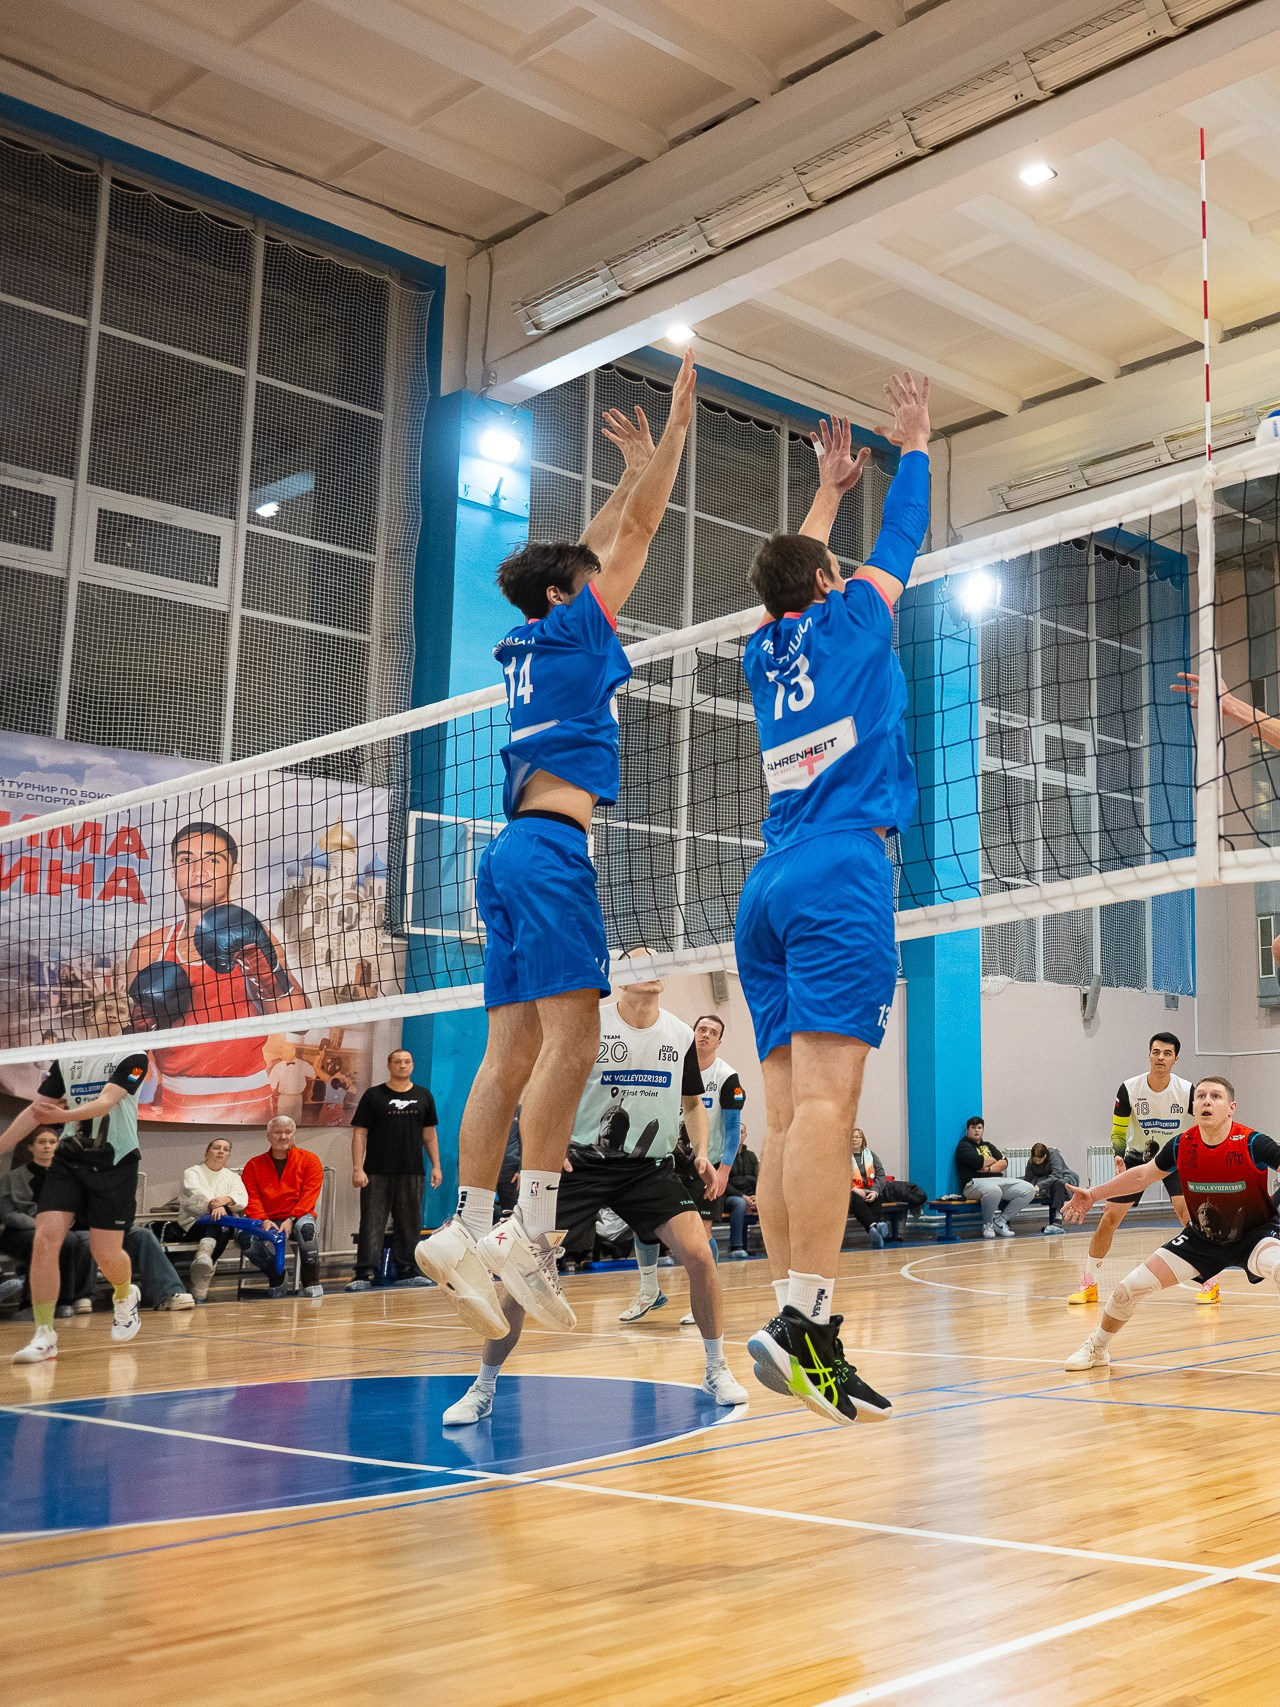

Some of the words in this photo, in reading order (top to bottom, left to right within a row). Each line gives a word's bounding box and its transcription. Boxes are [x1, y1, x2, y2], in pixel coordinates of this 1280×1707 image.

[504, 652, 534, 709] 14
[765, 653, 815, 721] 13
[0, 789, 24, 799] ТЕР
[26, 793, 77, 806] СПОРТА
[7, 780, 58, 792] ТУРНИР
[60, 787, 78, 796] ПО
[80, 790, 115, 800] БОКС
[596, 1041, 628, 1064] 20
[658, 1048, 679, 1062] 1380
[614, 1073, 667, 1084] VOLLEYDZR1380
[621, 1089, 638, 1097] First
[639, 1089, 659, 1098] Point
[1134, 1101, 1150, 1116] 18
